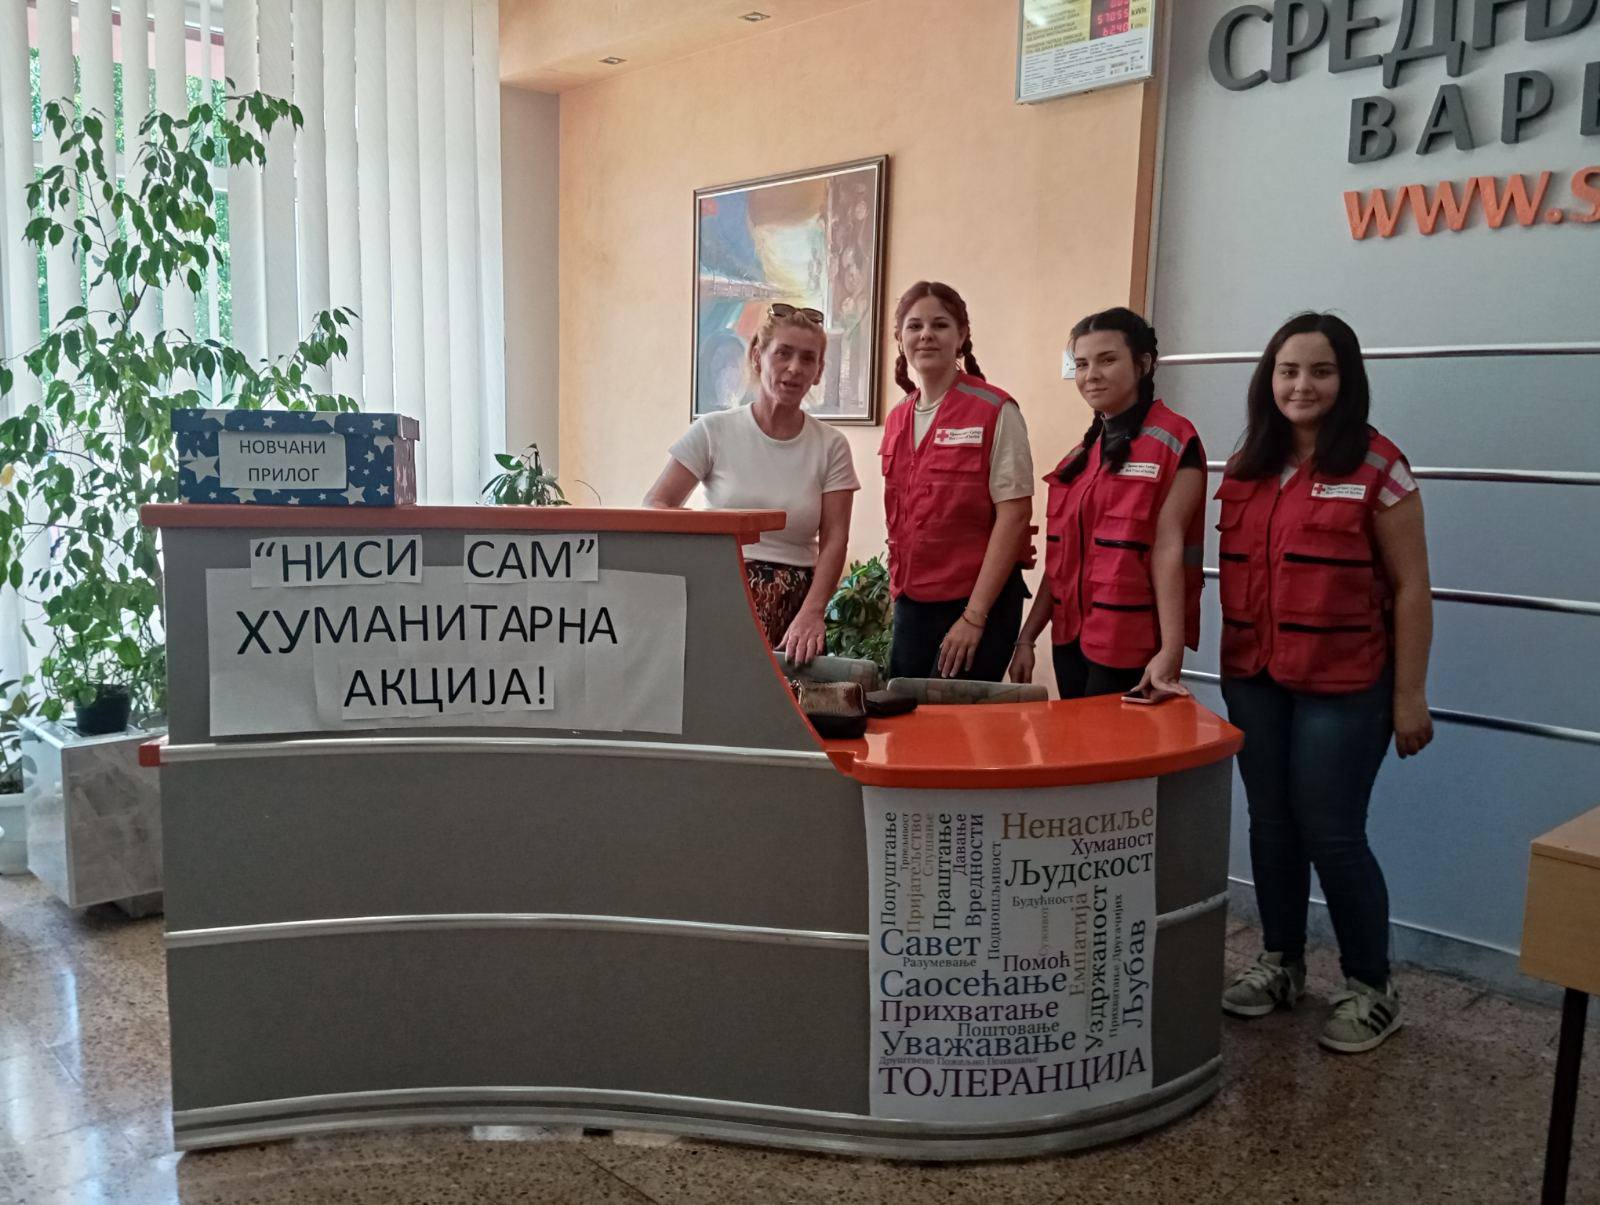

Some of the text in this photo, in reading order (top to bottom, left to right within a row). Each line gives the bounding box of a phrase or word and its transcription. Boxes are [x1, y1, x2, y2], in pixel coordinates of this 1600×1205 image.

[239, 438, 326, 456] НОВЧАНИ
[248, 466, 320, 484] ПРИЛОГ
[236, 604, 618, 656] ХУМАНИТАРНА
[343, 665, 546, 713] АКЦИЈА!
[953, 813, 968, 876] Давање
[1001, 806, 1154, 840] Ненасиље
[1071, 831, 1154, 860] Хуманост
[880, 811, 901, 927] Попуштање
[906, 812, 925, 934] Пријатељство
[933, 813, 956, 930] Праштање
[965, 813, 987, 928] Вредности
[1004, 851, 1154, 893] Људскост
[987, 841, 1002, 961] Подношљивост
[880, 928, 982, 957] Савет
[902, 957, 977, 970] Разумевање
[1003, 950, 1071, 972] Помоћ
[1069, 892, 1089, 997] Емпатија
[880, 969, 1068, 998] Саосећање
[1085, 885, 1108, 1053] Уздржаност
[1122, 919, 1150, 1029] Љубав
[880, 1000, 1060, 1028] Прихватање
[957, 1020, 1060, 1038] Поштовање
[880, 1030, 1077, 1058] Уважавање
[878, 1047, 1147, 1098] ТОЛЕРАНЦИЈА
